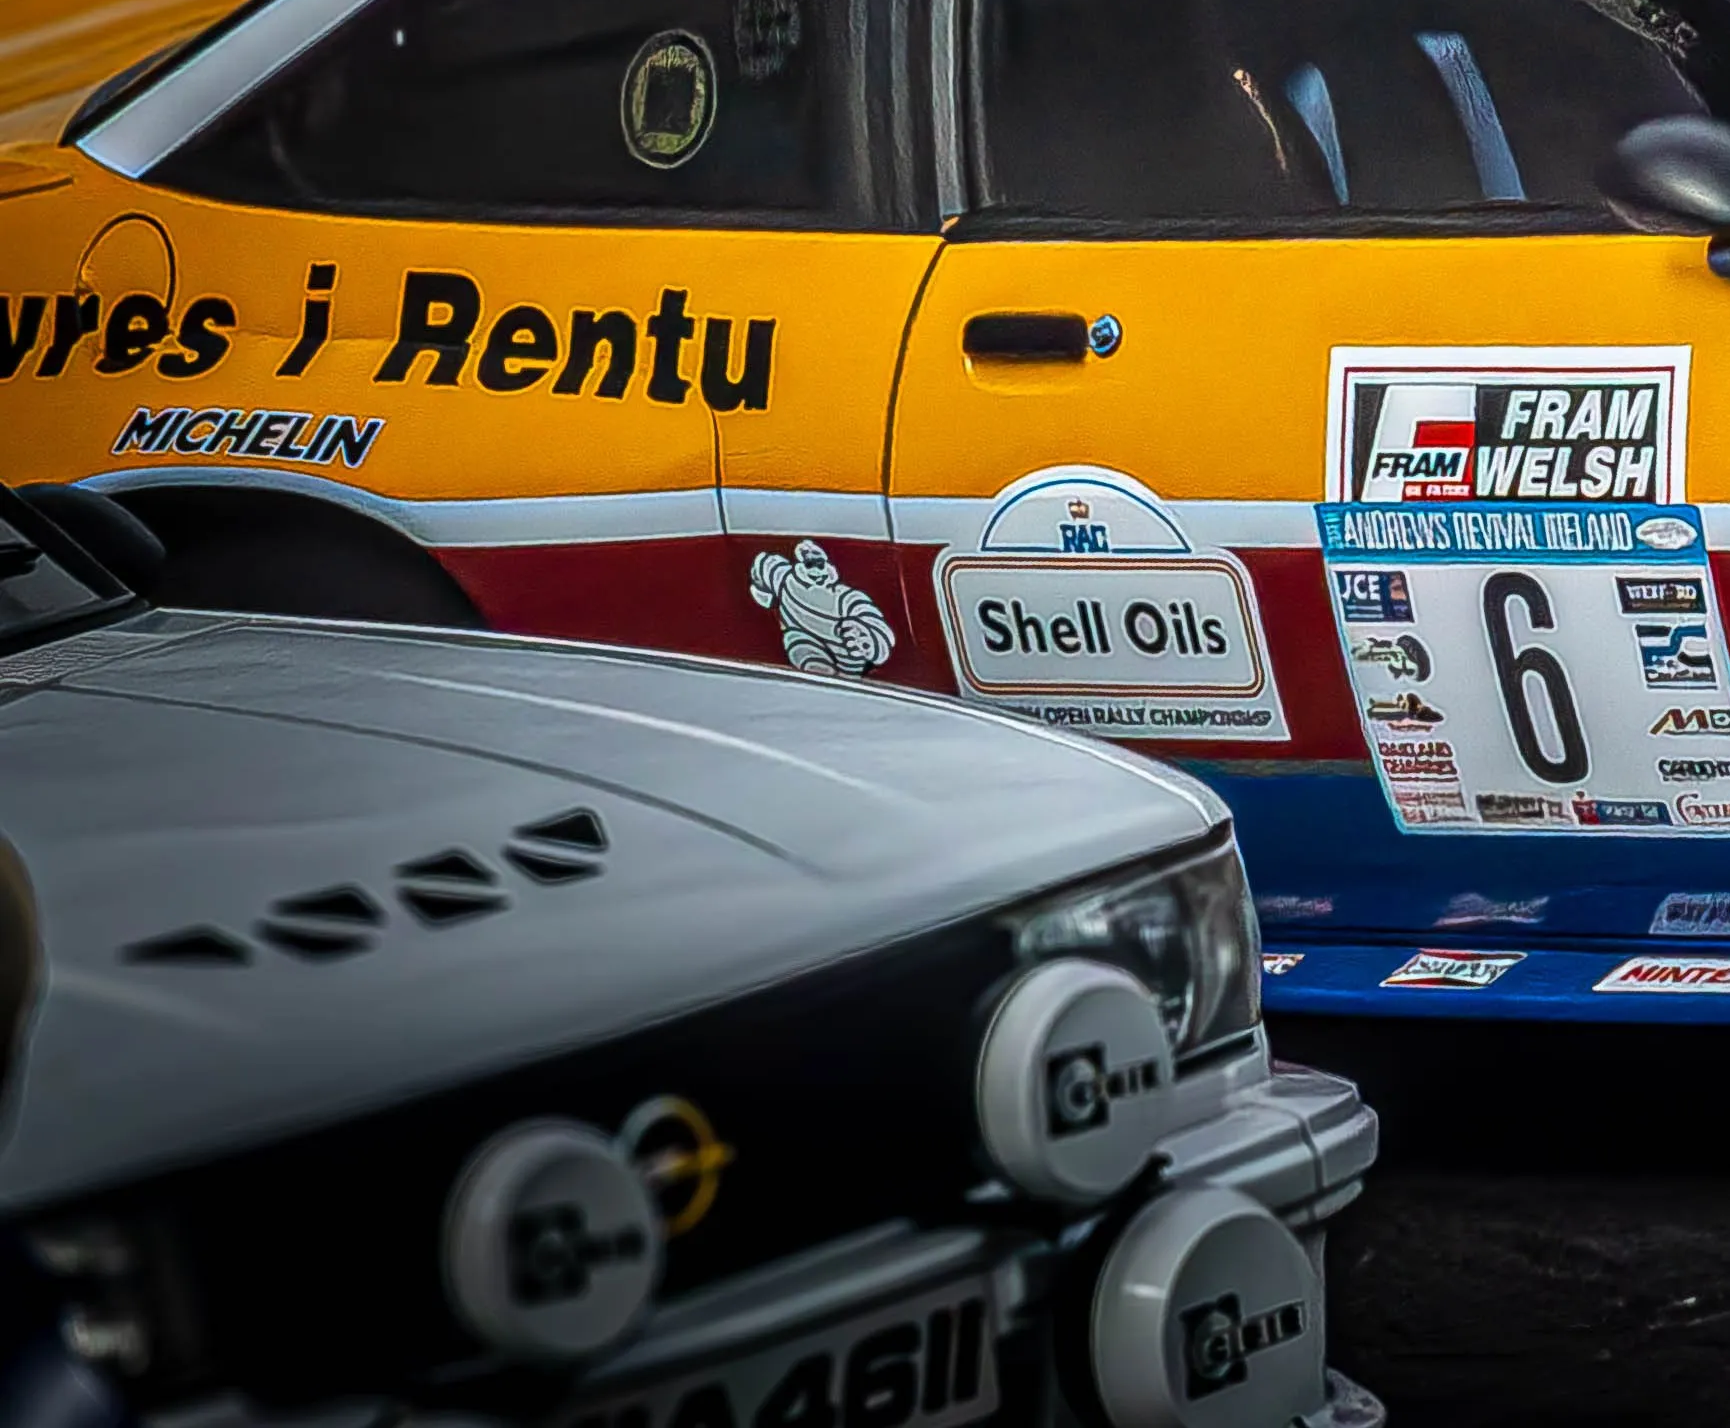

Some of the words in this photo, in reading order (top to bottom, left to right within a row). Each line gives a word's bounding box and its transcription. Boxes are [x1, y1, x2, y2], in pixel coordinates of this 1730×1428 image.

[373, 270, 778, 413] Rentu
[112, 406, 386, 469] MICHELIN
[1501, 388, 1654, 442] FRAM
[1372, 452, 1462, 479] FRAM
[1475, 445, 1655, 499] WELSH
[1061, 524, 1107, 552] RAC
[1343, 510, 1450, 551] ANDREWS
[977, 600, 1111, 655] Shell
[1125, 600, 1227, 656] Oils
[1482, 572, 1590, 784] 6
